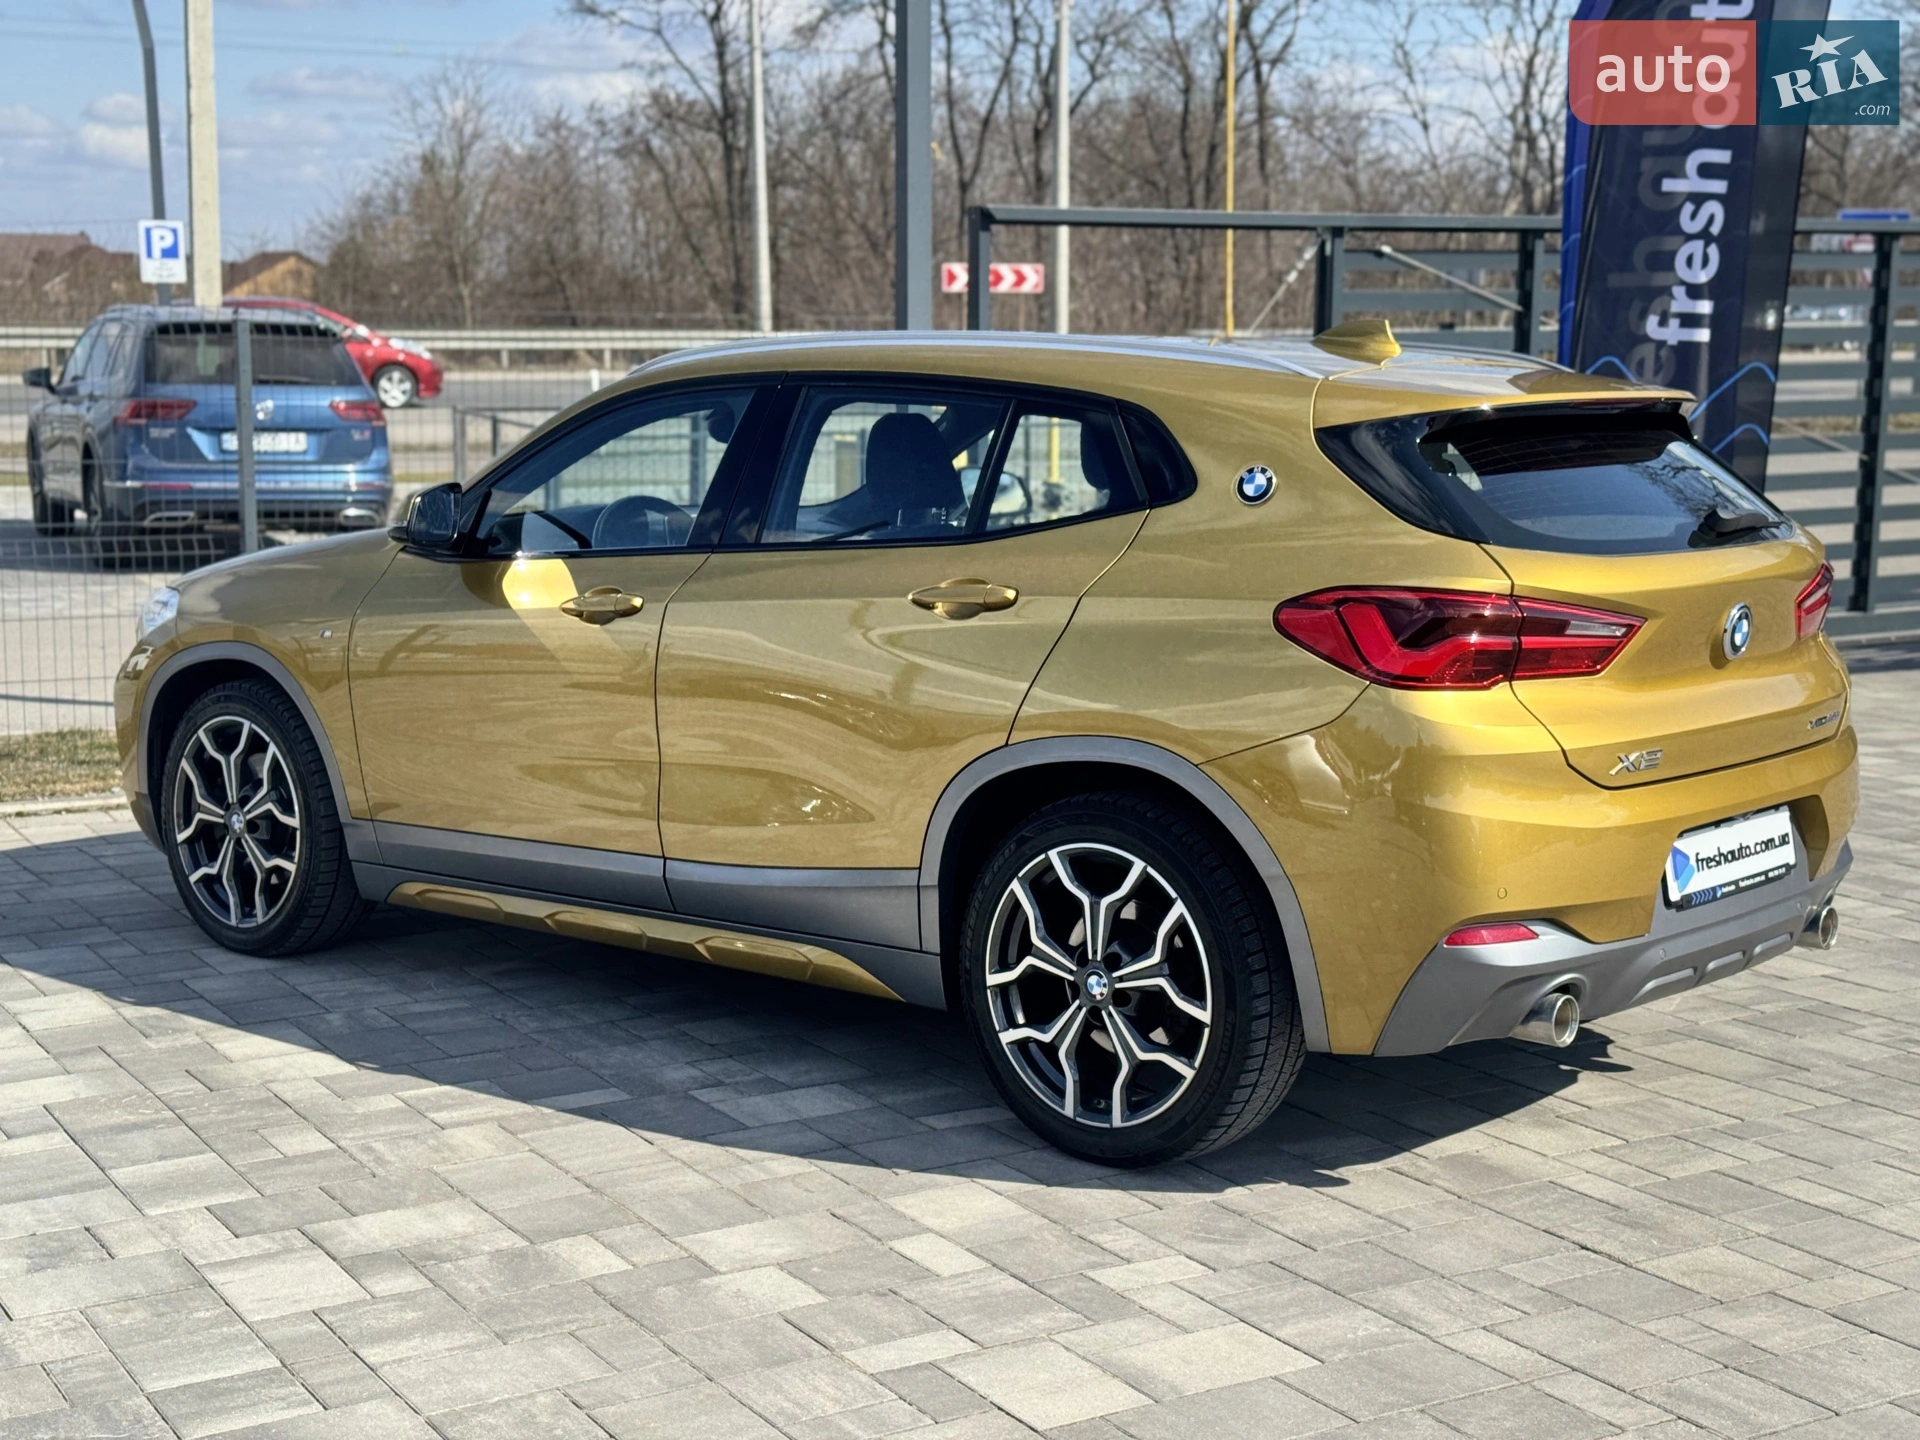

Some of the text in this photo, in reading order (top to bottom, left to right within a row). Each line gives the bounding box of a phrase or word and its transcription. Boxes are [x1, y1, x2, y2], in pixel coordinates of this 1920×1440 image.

[150, 226, 176, 260] P
[1645, 147, 1733, 346] fresh
[1609, 748, 1663, 776] X2
[1695, 831, 1790, 873] freshauto.com.ua
